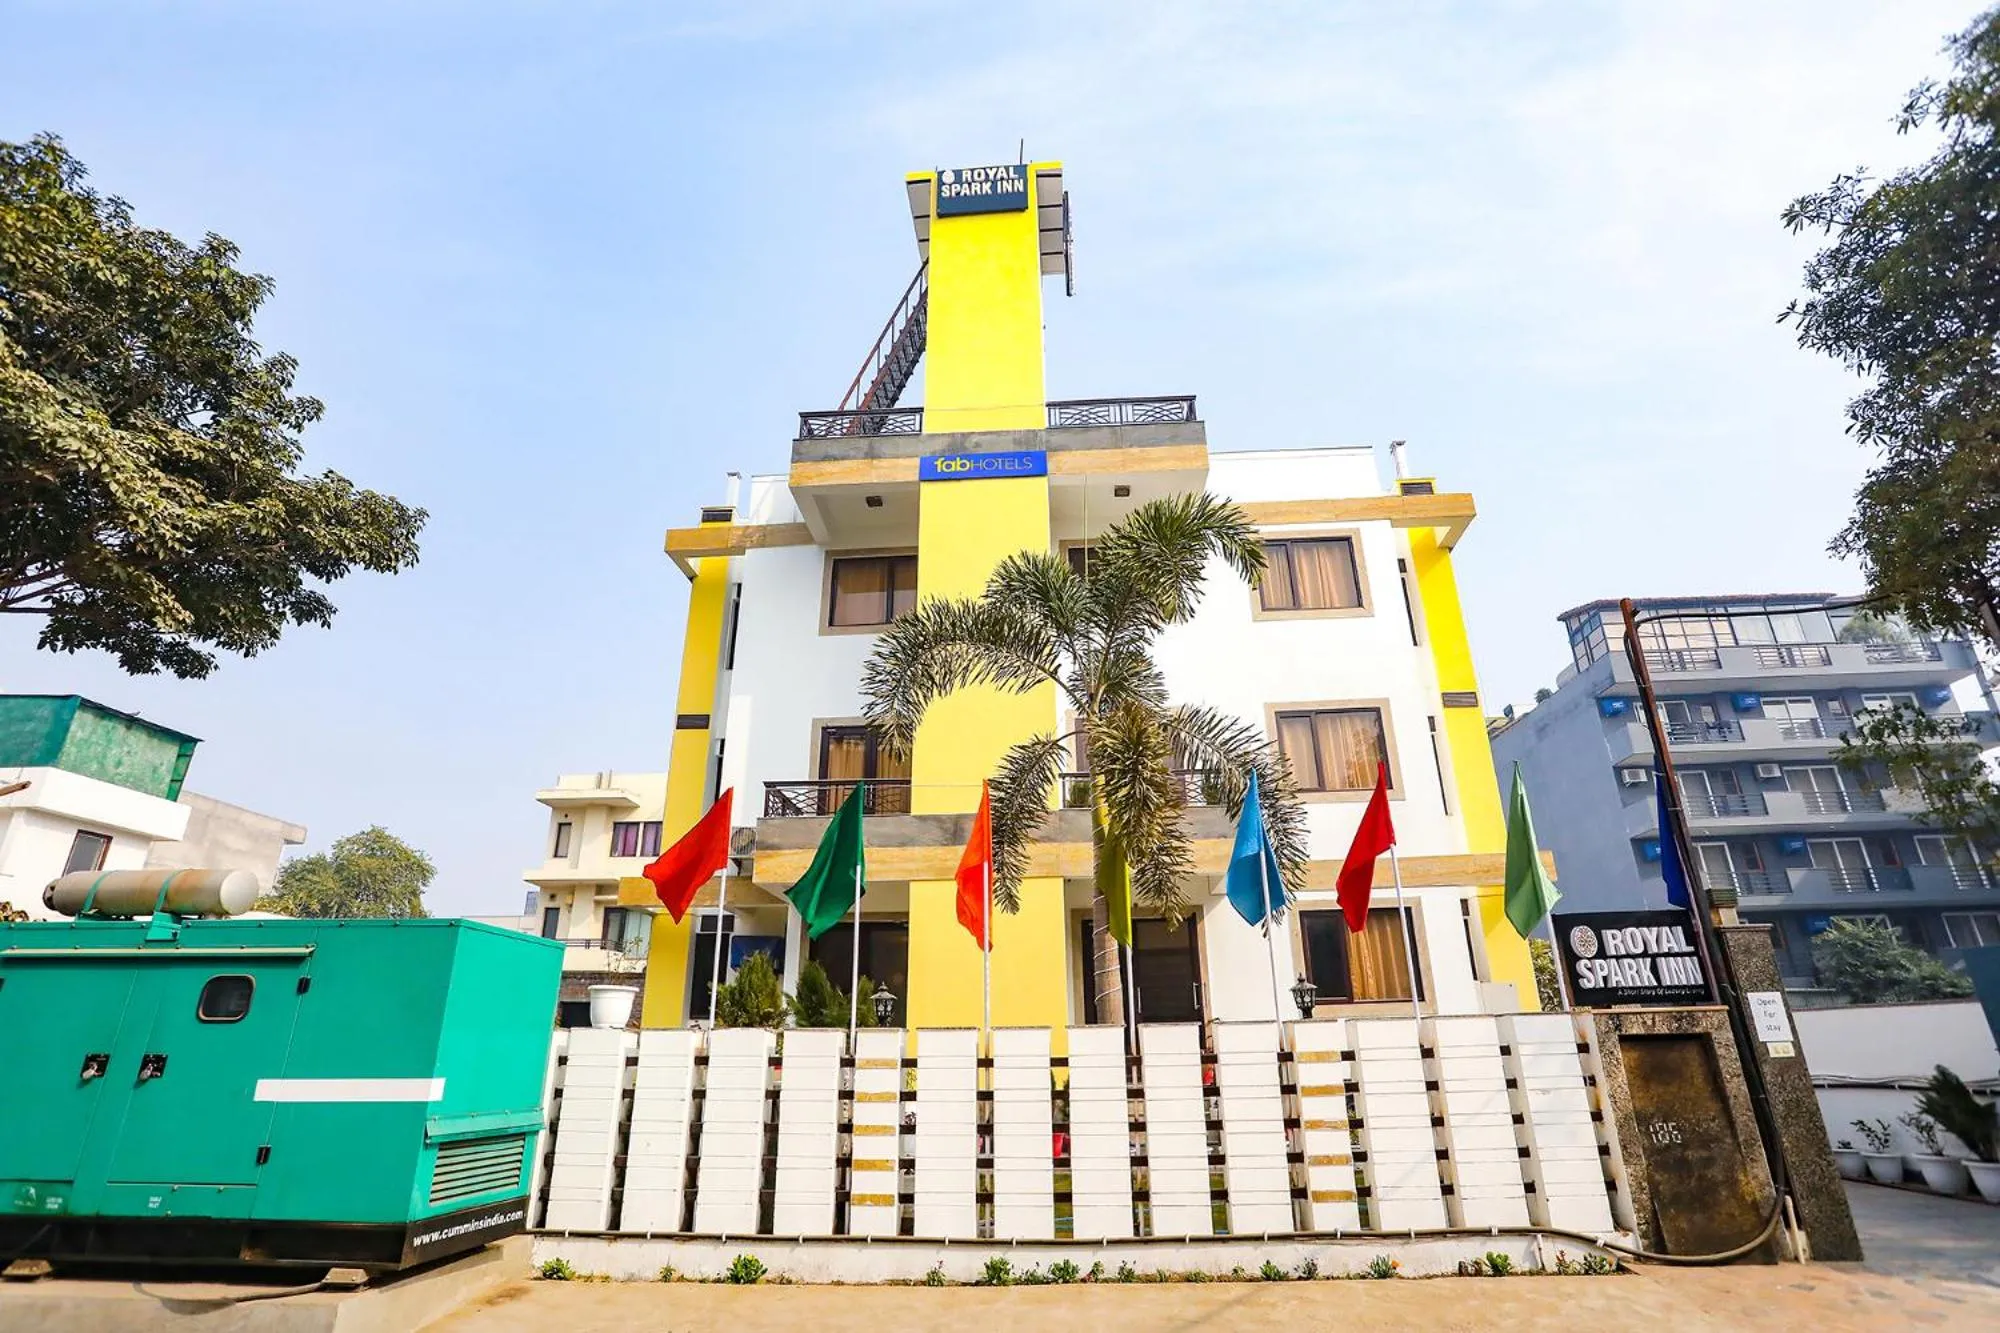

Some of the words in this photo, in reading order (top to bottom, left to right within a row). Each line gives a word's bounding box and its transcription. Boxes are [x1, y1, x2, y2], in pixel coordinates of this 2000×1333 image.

[962, 167, 1018, 182] ROYAL
[941, 182, 992, 197] SPARK
[997, 179, 1024, 193] INN
[934, 456, 1033, 472] fabHOTELS
[1601, 926, 1695, 956] ROYAL
[1576, 957, 1658, 989] SPARK
[1656, 956, 1704, 986] INN
[413, 1210, 523, 1247] www.cumminsindia.com
